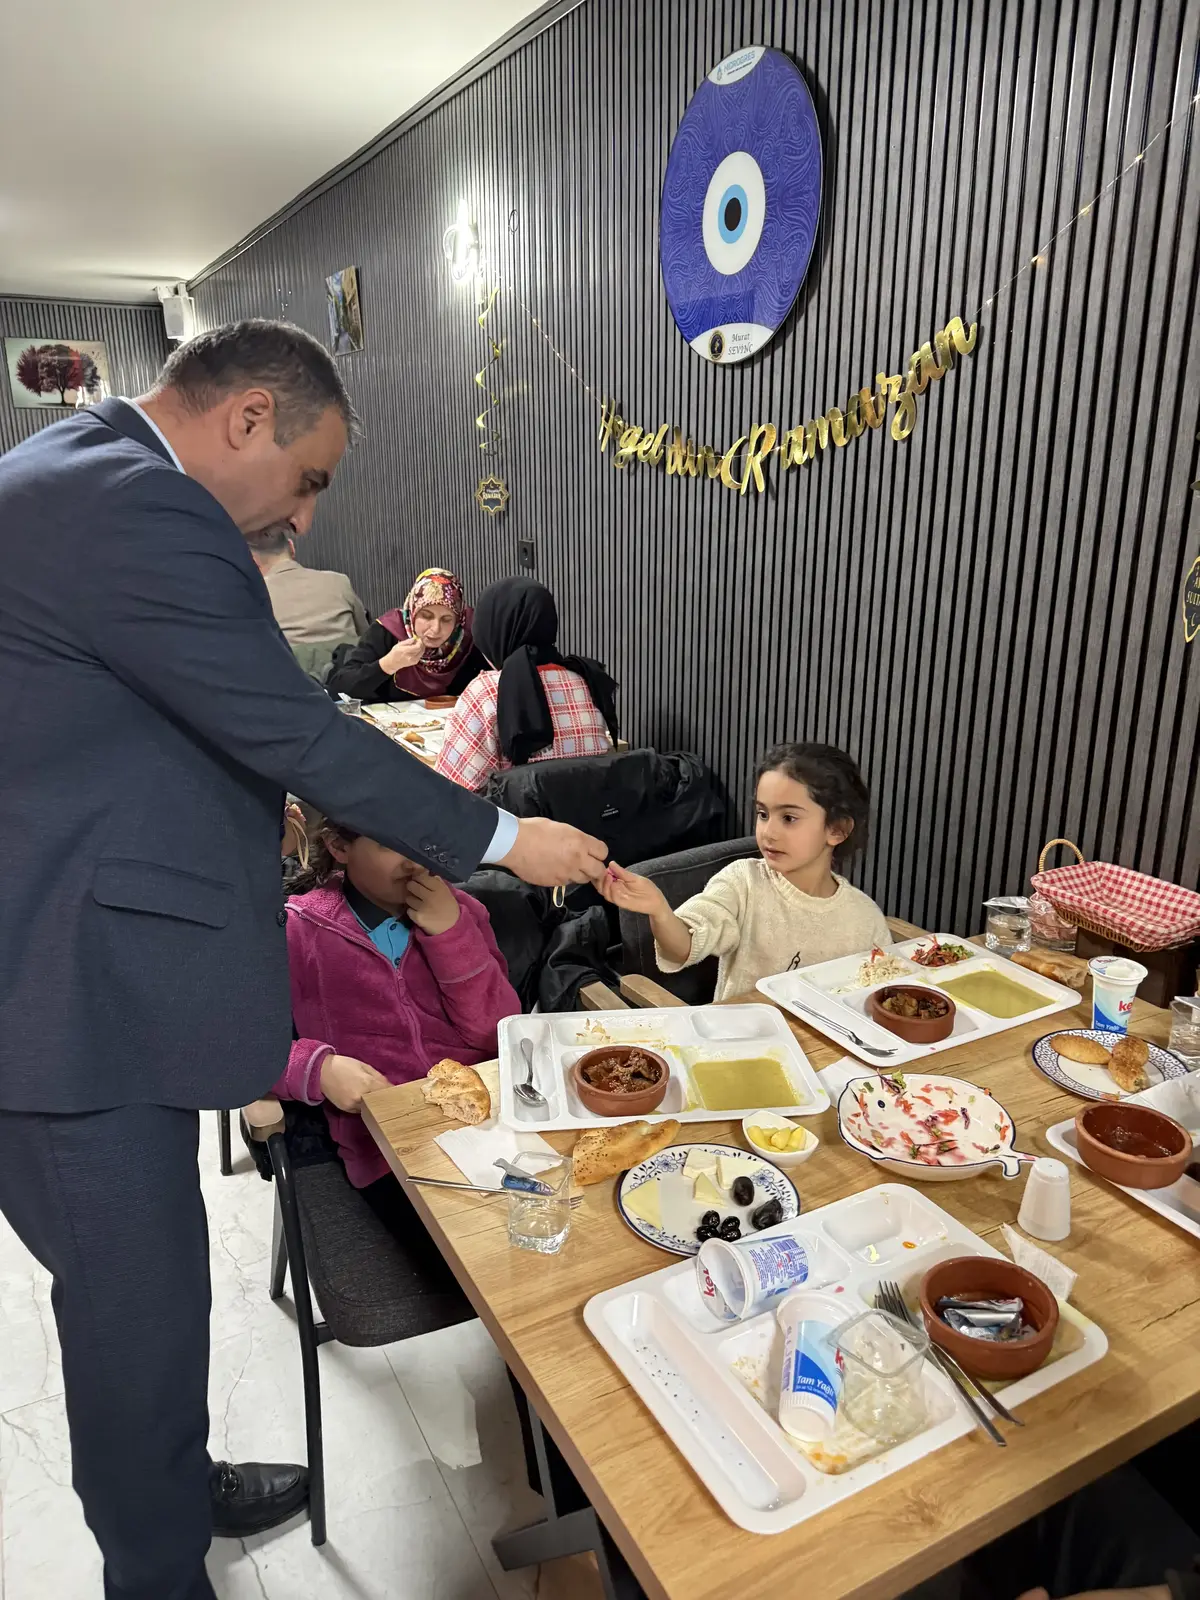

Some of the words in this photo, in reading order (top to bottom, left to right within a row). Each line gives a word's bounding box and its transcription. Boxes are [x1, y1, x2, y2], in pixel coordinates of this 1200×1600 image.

[731, 333, 750, 342] Murat
[720, 316, 977, 495] Ramazan
[797, 1375, 815, 1386] Tam
